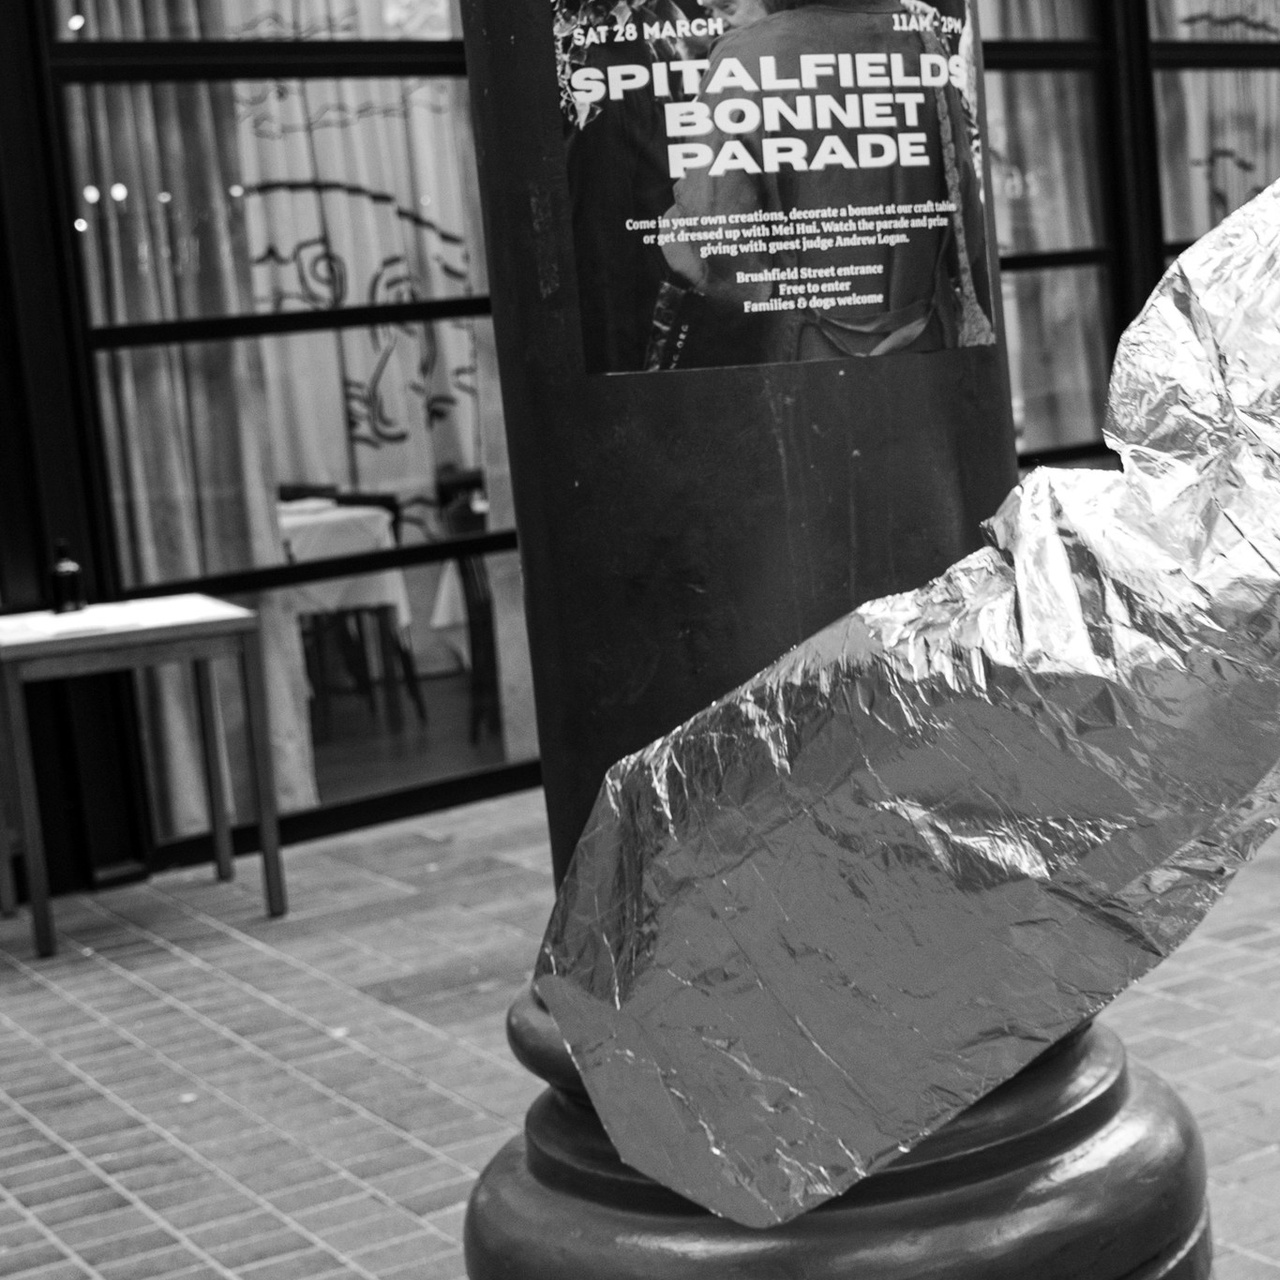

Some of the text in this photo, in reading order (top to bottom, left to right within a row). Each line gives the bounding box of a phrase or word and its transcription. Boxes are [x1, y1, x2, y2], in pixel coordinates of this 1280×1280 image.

[573, 25, 608, 46] SAT
[613, 23, 638, 42] 28
[643, 18, 724, 39] MARCH
[892, 13, 932, 32] 11AM
[940, 16, 962, 34] 2PM
[570, 53, 965, 102] SPITALFIELDS
[664, 93, 925, 138] BONNET
[667, 133, 930, 178] PARADE
[625, 200, 957, 231] Come in your own creations, decorate a bonnet at our craft tables
[643, 214, 948, 246] or get dressed up with Mei Hui. Watch the parade and prize
[700, 233, 910, 258] giving with guest judge Andrew Logan.
[736, 264, 884, 283] Brushfield Street entrance
[779, 281, 852, 295] Free to enter
[743, 293, 884, 313] Families & dogs welcome
